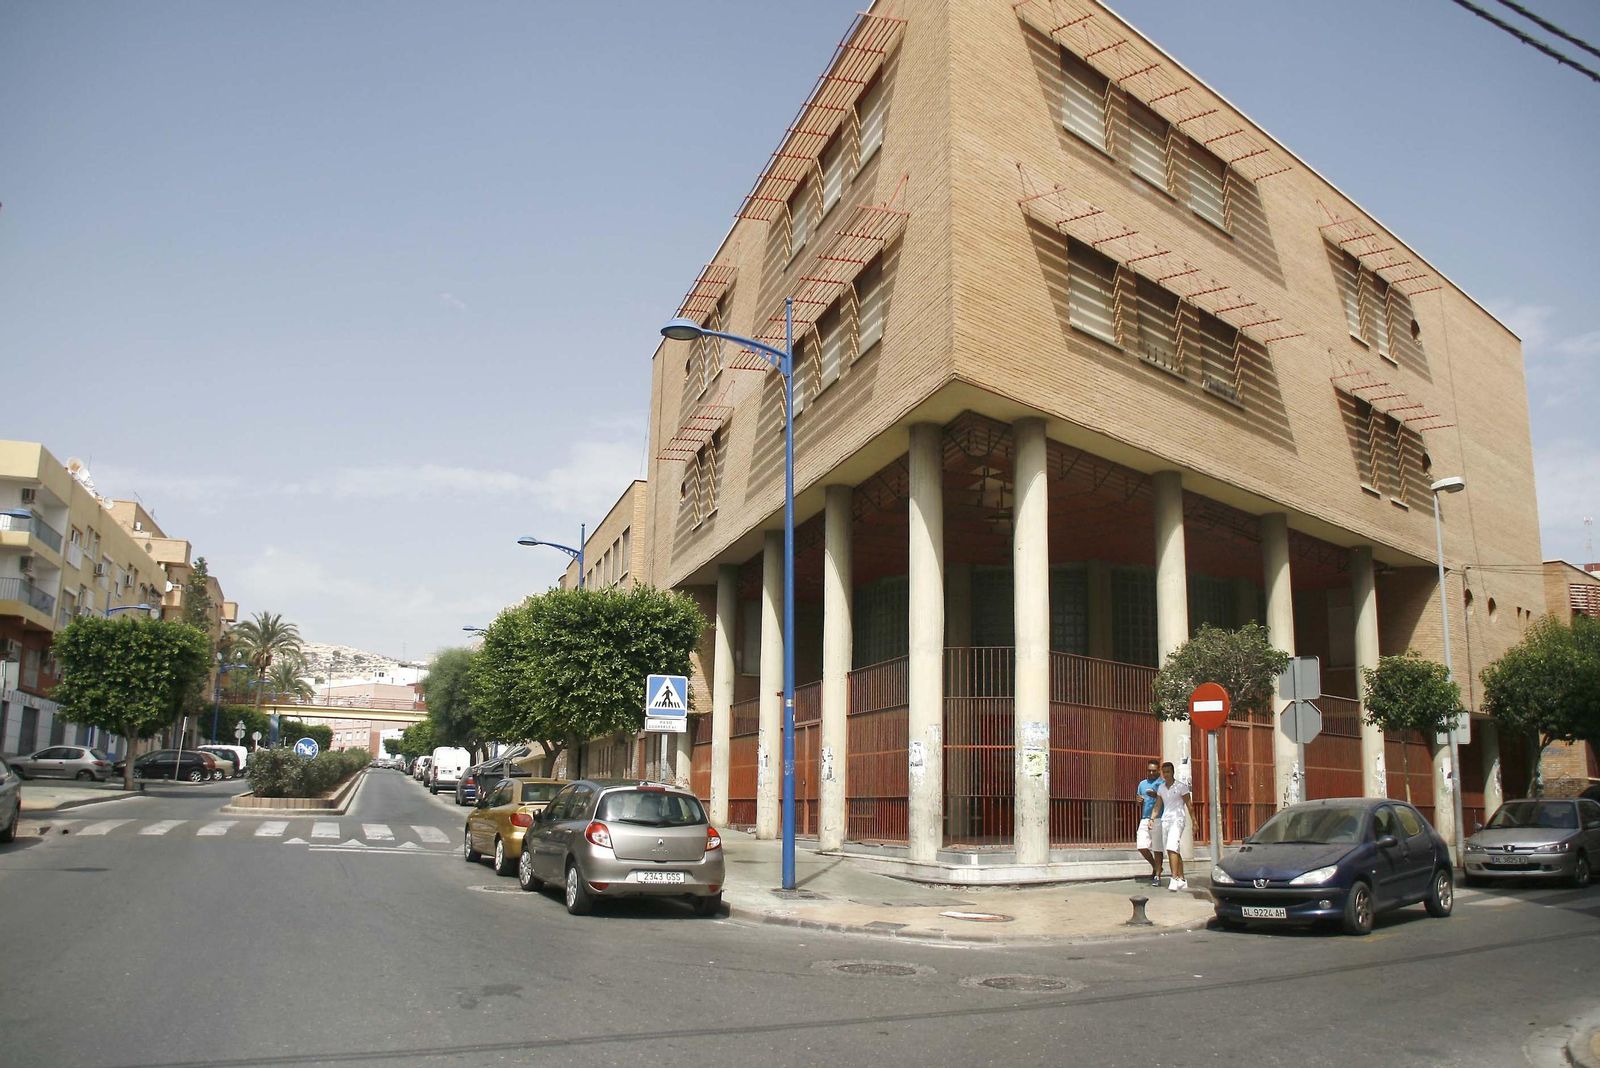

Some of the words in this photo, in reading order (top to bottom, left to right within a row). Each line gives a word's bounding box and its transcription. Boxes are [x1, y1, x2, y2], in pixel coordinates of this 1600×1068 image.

[643, 872, 663, 881] 2343
[666, 872, 681, 881] GSS
[1243, 908, 1253, 917] AL
[1253, 908, 1274, 917] 9224
[1275, 909, 1285, 918] AH
